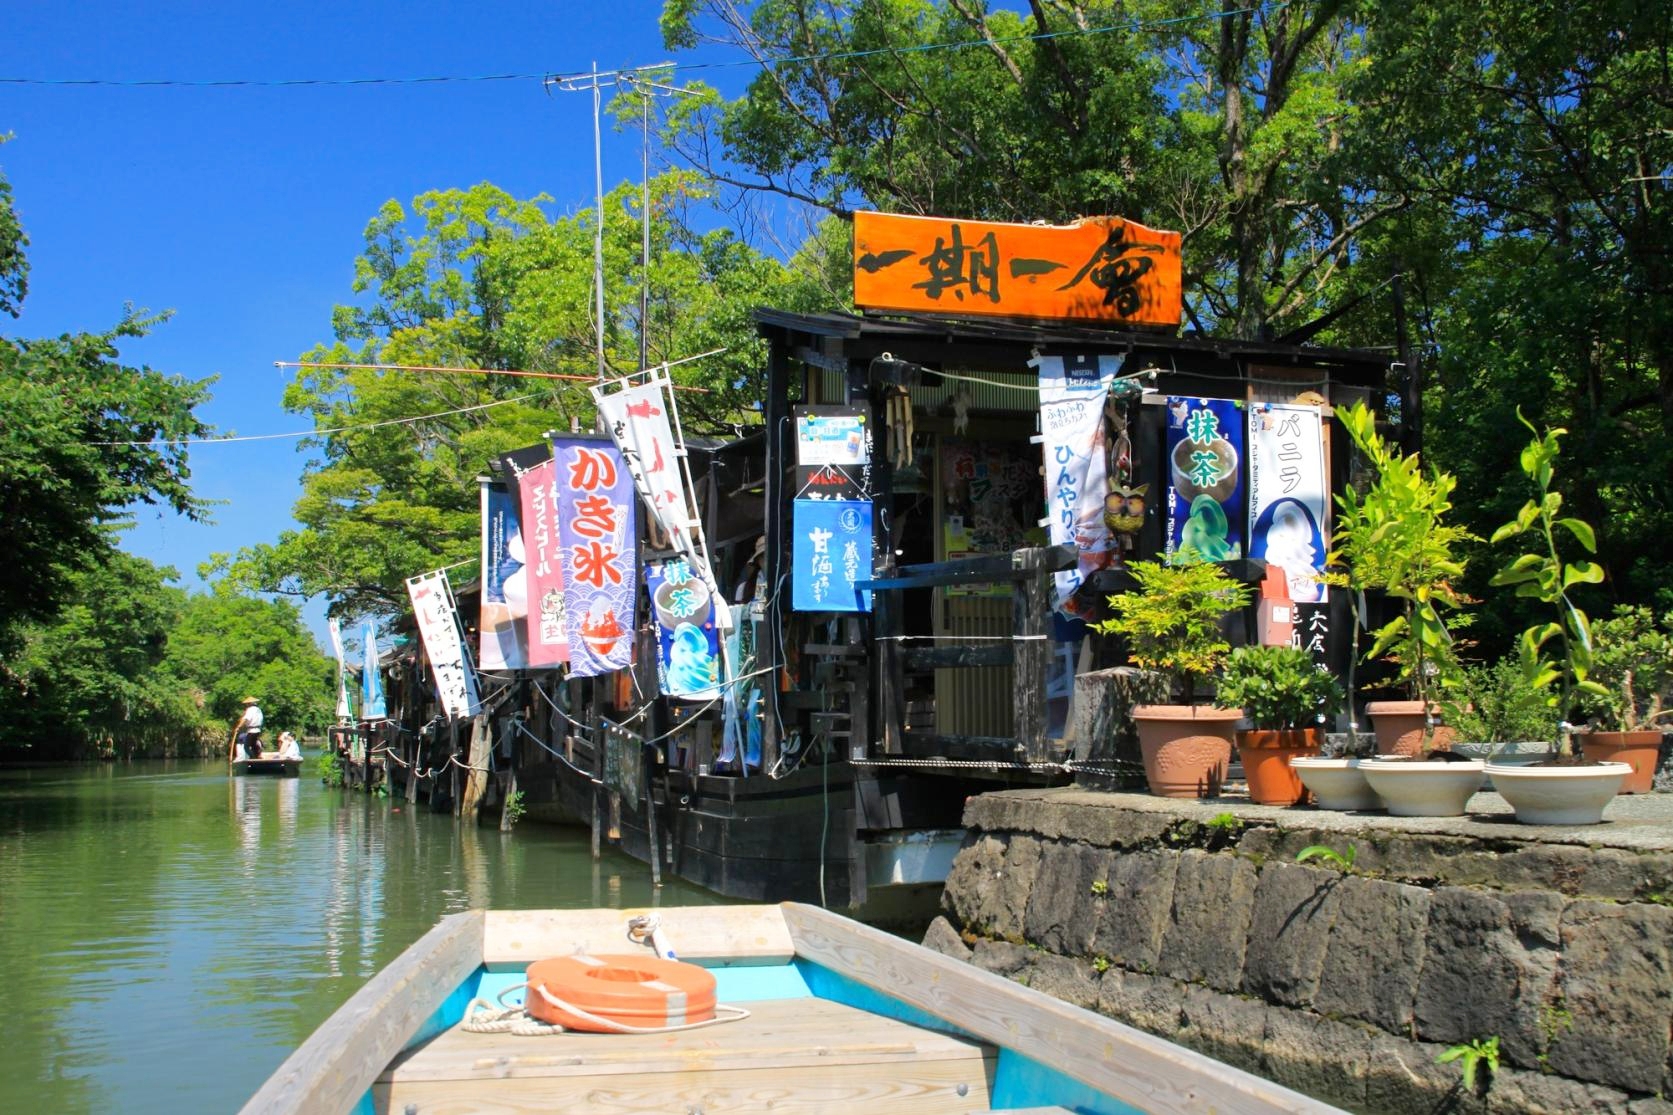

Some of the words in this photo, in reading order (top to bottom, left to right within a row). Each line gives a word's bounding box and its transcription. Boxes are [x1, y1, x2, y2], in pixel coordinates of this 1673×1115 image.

[1188, 409, 1221, 487] 抹茶
[1277, 413, 1303, 494] バニラ
[569, 447, 621, 588] かき氷
[1168, 486, 1176, 515] TOMI
[808, 527, 834, 577] 甘酒
[664, 560, 696, 618] 抹茶
[654, 620, 662, 643] TOMI
